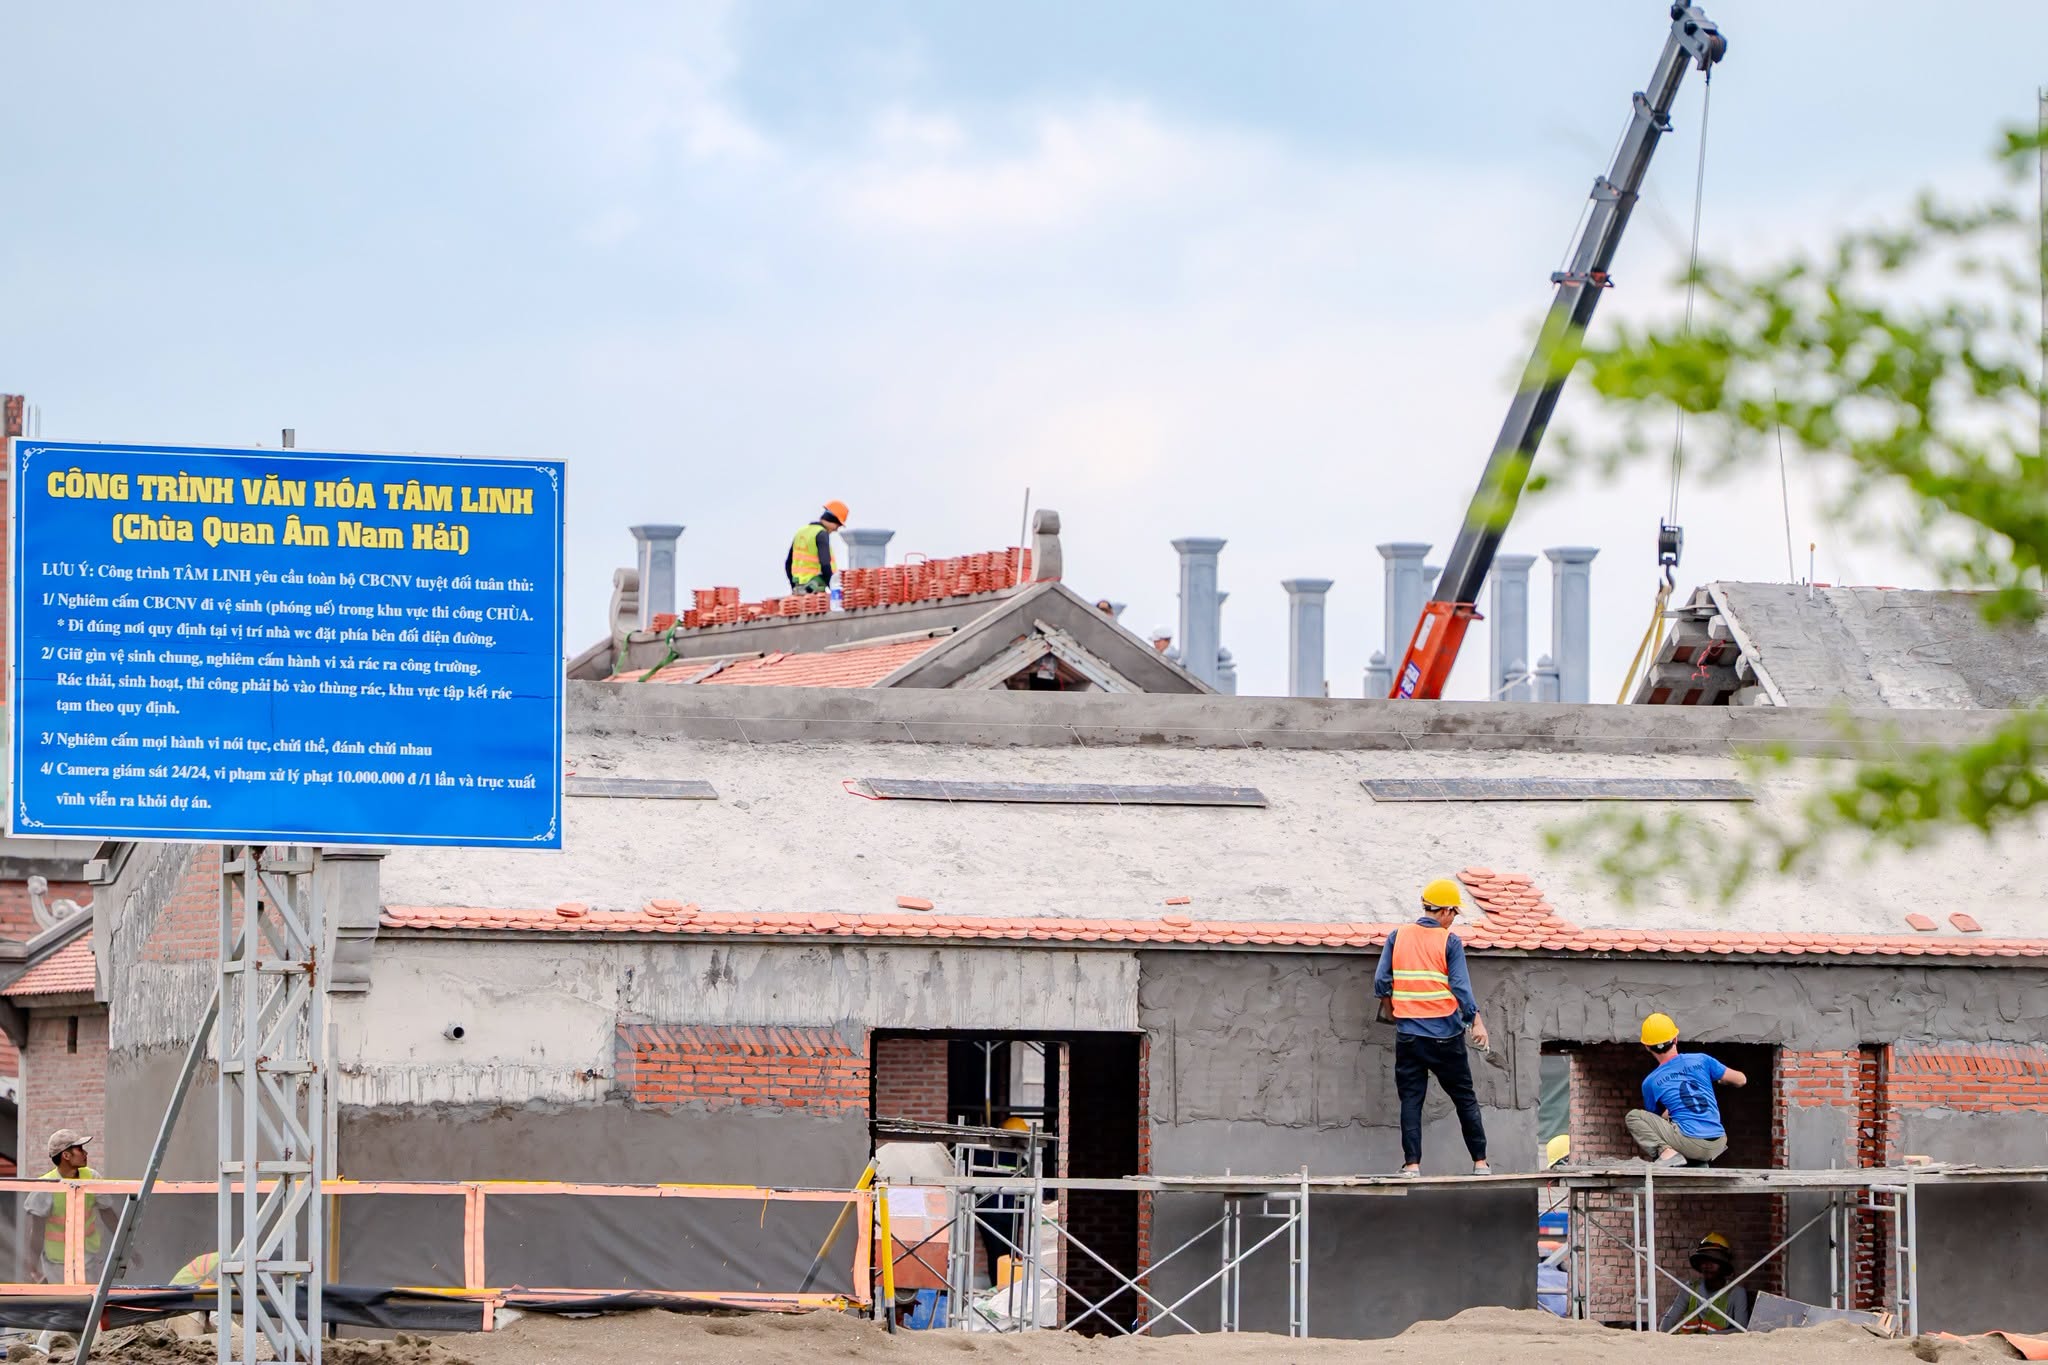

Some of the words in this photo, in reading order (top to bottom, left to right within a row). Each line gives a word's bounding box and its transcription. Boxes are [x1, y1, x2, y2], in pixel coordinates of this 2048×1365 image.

[47, 466, 129, 501] CÔNG
[136, 470, 234, 504] TRÌNH
[241, 473, 307, 507] VĂN
[313, 476, 377, 509] HÓA
[383, 479, 454, 512] TÂM
[460, 486, 534, 515] LINH
[112, 513, 194, 544] (Chùa
[202, 516, 276, 548] Quan
[282, 513, 330, 547] Âm
[337, 521, 405, 549] Nam
[411, 522, 470, 556] Hải)
[42, 561, 75, 577] LƯU
[78, 560, 94, 577] Ý:
[97, 564, 134, 582] Công
[136, 565, 170, 580] trình
[172, 563, 209, 581] TÂM
[212, 568, 251, 583] LINH
[254, 569, 278, 586] yêu
[307, 571, 336, 585] toàn
[339, 572, 356, 589] bộ
[358, 573, 412, 588] CBCNV
[415, 575, 448, 592] tuyệt
[451, 574, 472, 590] đối
[475, 577, 505, 591] tuân
[507, 578, 534, 592] thủ:
[43, 592, 55, 606] 1/
[57, 592, 109, 610] Nghiêm
[142, 595, 198, 610] CBCNV
[200, 597, 214, 611] đi
[217, 598, 233, 615] vệ
[235, 599, 263, 613] sinh
[265, 600, 312, 617] (phóng
[338, 603, 375, 619] trong
[377, 603, 403, 617] khu
[405, 606, 429, 621] vực
[431, 605, 449, 619] thi
[452, 605, 483, 623] công
[485, 604, 534, 622] CHÙA.
[67, 618, 84, 632] Đi
[86, 619, 121, 636] đúng
[124, 621, 145, 634] nơi
[147, 624, 173, 638] quy
[176, 622, 207, 639] định
[209, 623, 227, 640] tại
[230, 624, 243, 640] vị
[246, 624, 263, 638] trí
[265, 625, 291, 639] nhà
[293, 629, 312, 640] wc
[314, 626, 337, 643] đặt
[339, 627, 369, 644] phía
[371, 628, 396, 642] bên
[398, 627, 419, 643] đối
[421, 630, 450, 647] diện
[452, 631, 497, 648] đường.
[41, 646, 55, 660] 2/
[56, 647, 83, 661] Giữ
[85, 647, 107, 664] gìn
[109, 648, 125, 665] vệ
[127, 649, 156, 663] sinh
[158, 650, 204, 668] chung,
[206, 652, 255, 668] nghiêm
[287, 654, 321, 668] hành
[324, 655, 336, 669] vi
[339, 655, 355, 670] xả
[358, 656, 380, 670] rác
[383, 661, 398, 671] ra
[400, 658, 432, 675] công
[433, 659, 481, 677] trường.
[57, 672, 83, 686] Rác
[85, 673, 116, 689] thải,
[118, 674, 147, 688] sinh
[149, 675, 184, 692] hoạt,
[186, 676, 205, 690] thi
[207, 676, 239, 694] công
[241, 677, 271, 694] phải
[273, 678, 290, 693] bỏ
[292, 679, 317, 693] vào
[319, 680, 358, 698] thùng
[360, 682, 386, 698] rác,
[388, 682, 414, 697] khu
[417, 686, 441, 701] vực
[443, 684, 465, 701] tập
[491, 686, 513, 700] rác
[56, 699, 82, 715] tạm
[85, 699, 115, 713] theo
[117, 703, 143, 717] quy
[145, 700, 180, 717] định.
[40, 731, 55, 745] 3/
[56, 732, 108, 749] Nghiêm
[142, 735, 168, 751] mọi
[170, 735, 205, 749] hành
[207, 736, 220, 750] vi
[223, 736, 244, 750] nói
[331, 740, 365, 754] đánh
[399, 742, 433, 756] nhau
[40, 761, 54, 775] 4/
[56, 762, 110, 777] Camera
[112, 763, 146, 780] giám
[148, 764, 169, 778] sát
[171, 765, 211, 781] 24/24,
[213, 766, 226, 780] vi
[228, 767, 267, 784] phạm
[269, 767, 286, 782] xử
[287, 768, 300, 785] lý
[303, 769, 333, 786] phạt
[337, 770, 405, 785] 10.000.000
[434, 770, 456, 787] lần
[458, 773, 474, 787] và
[477, 775, 505, 791] trục
[507, 773, 536, 789] xuất
[56, 792, 86, 806] vĩnh
[119, 797, 135, 807] ra
[137, 793, 167, 808] khỏi
[170, 795, 189, 812] dự
[191, 795, 212, 809] án.
[1679, 1080, 1709, 1114] 6
